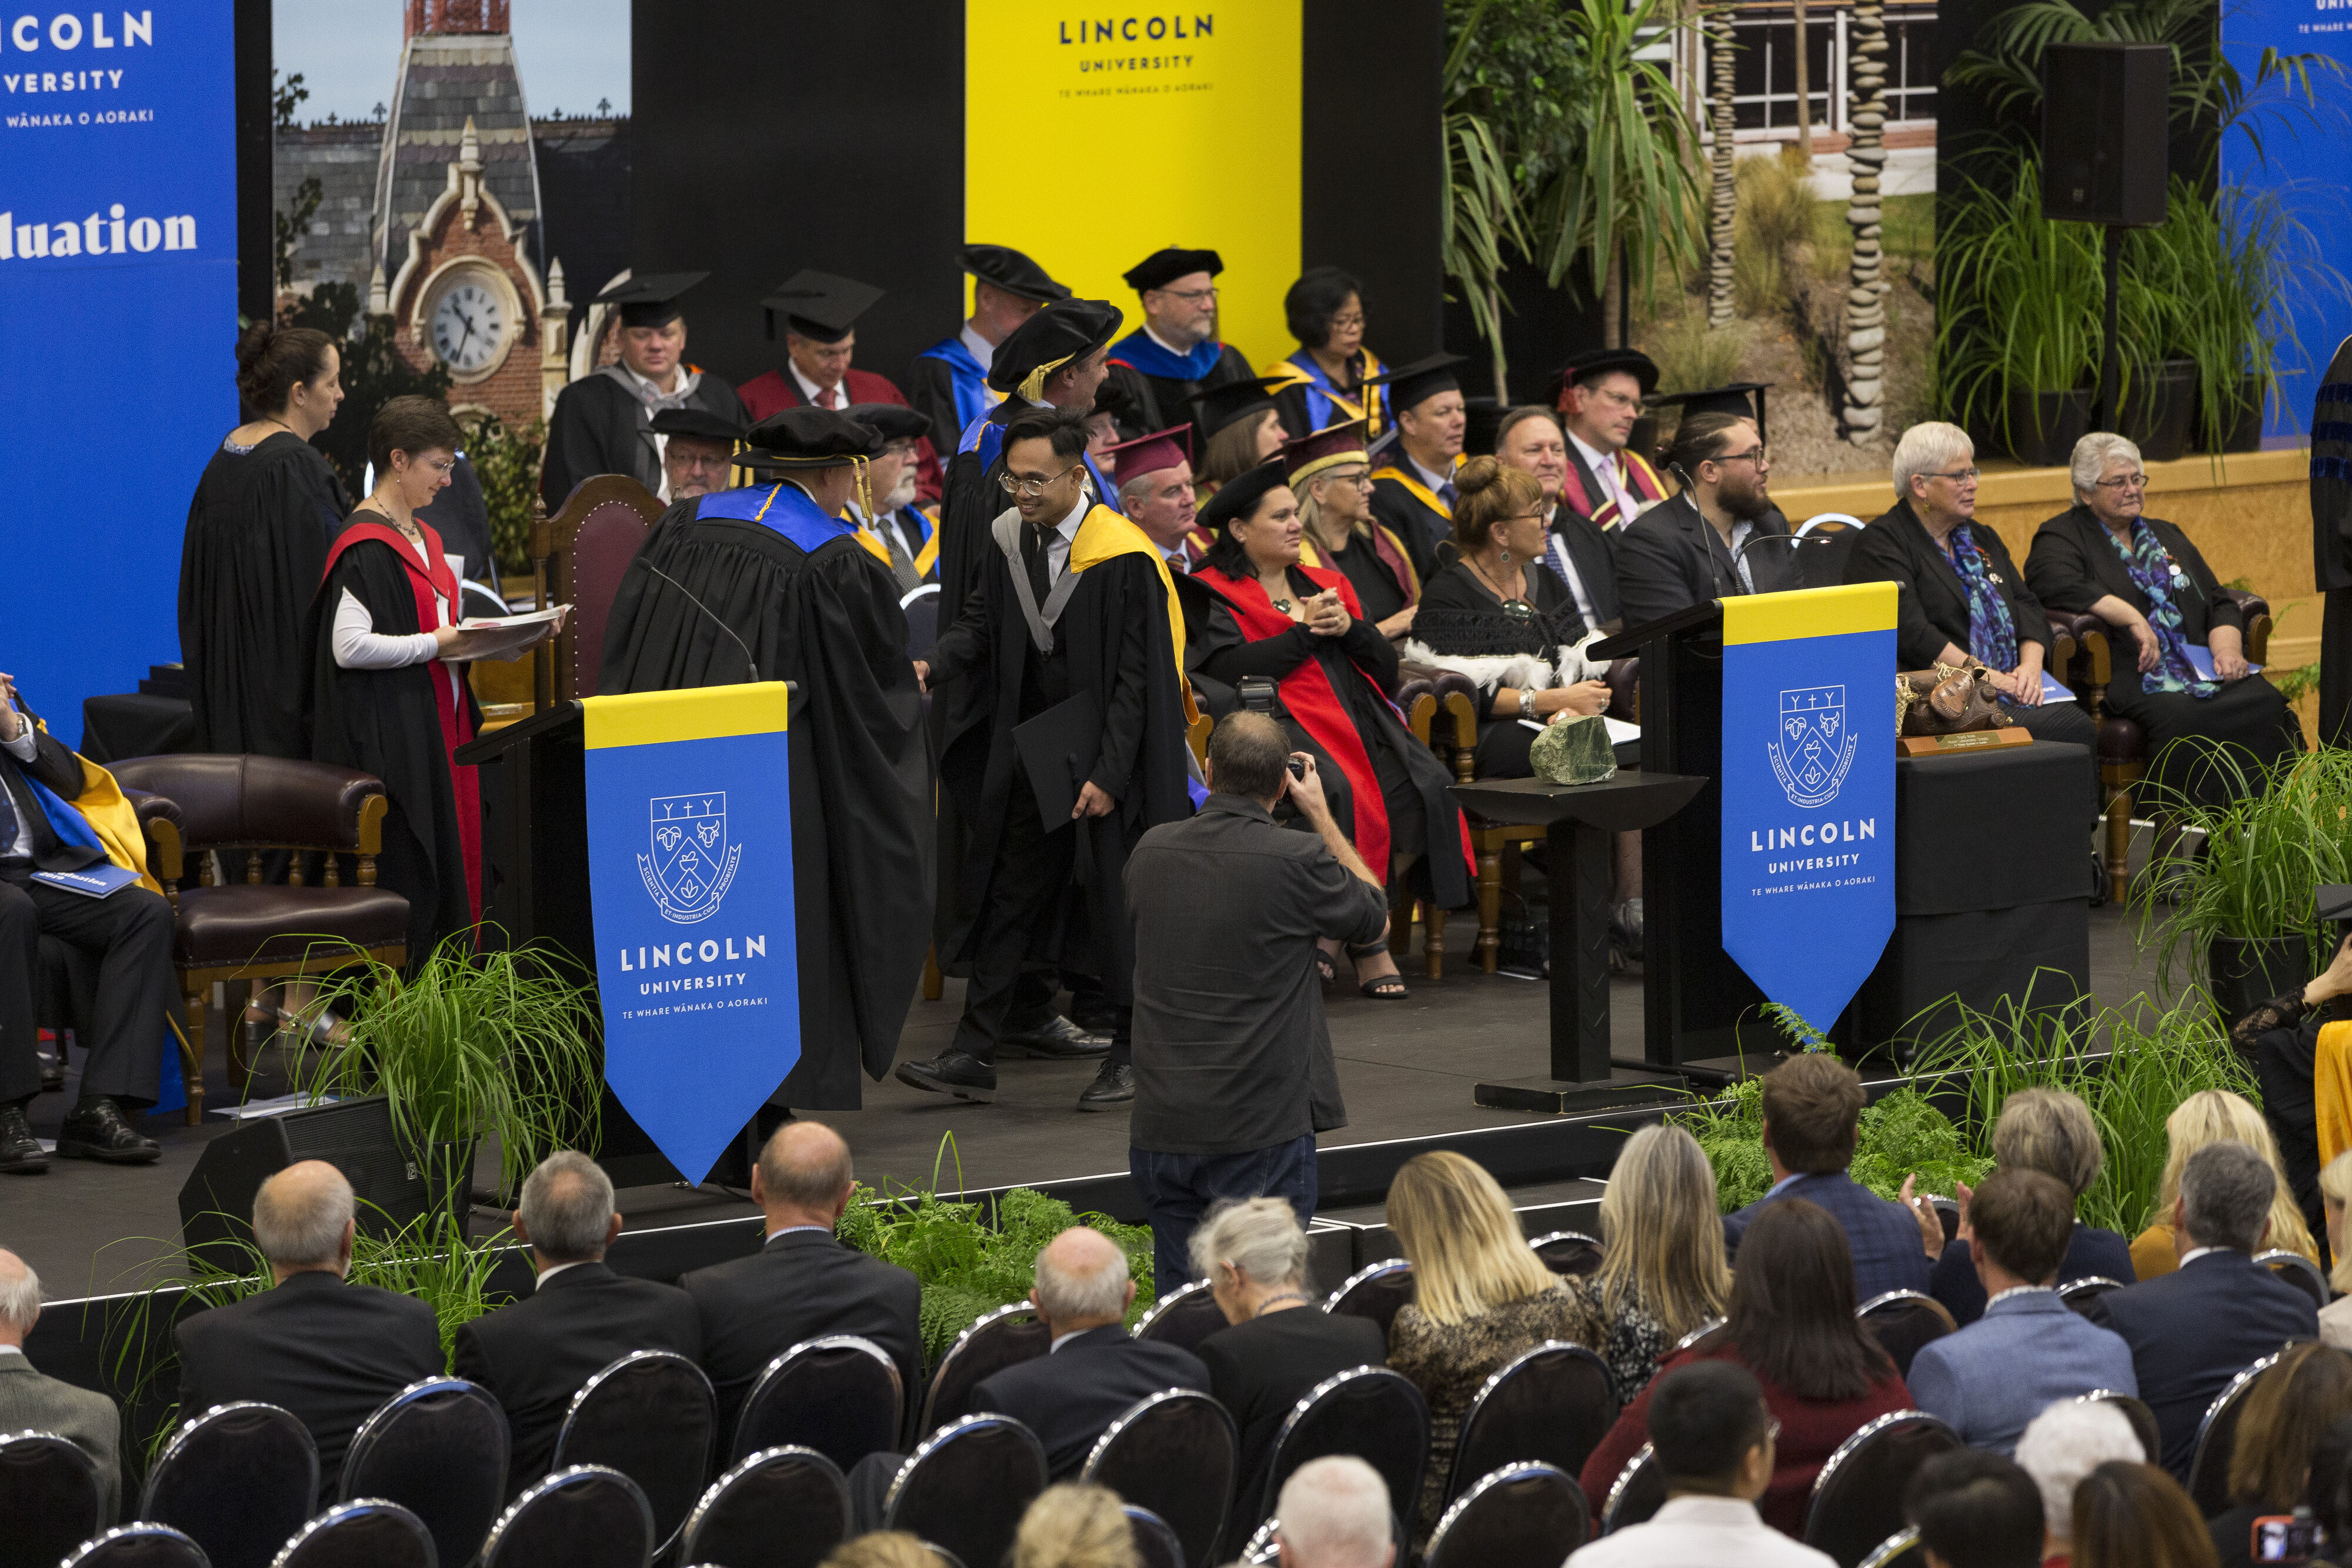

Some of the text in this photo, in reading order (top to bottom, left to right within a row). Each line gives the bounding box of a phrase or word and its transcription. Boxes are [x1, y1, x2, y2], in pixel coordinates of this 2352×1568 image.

[0, 10, 152, 52] COLN
[1060, 14, 1213, 45] LINCOLN
[1080, 55, 1193, 72] UNIVERSITY
[4, 69, 124, 94] VERSITY
[78, 112, 90, 125] O
[95, 109, 154, 124] AORAKI
[1773, 754, 1788, 783] SCIENTIA
[1838, 744, 1853, 778] PROBITATE
[1752, 818, 1875, 852] LINCOLN
[1769, 853, 1859, 874] UNIVERSITY
[643, 866, 660, 898] SCIENTIA
[718, 855, 737, 891] PROBITATE
[1765, 885, 1794, 895] WHARE
[1797, 881, 1832, 891] WĀNAKA
[1844, 876, 1876, 886] AORAKI
[621, 935, 766, 972] LINCOLN
[640, 973, 746, 995] UNIVERSITY
[622, 997, 768, 1019] TE WHARE WĀNAKA O AORAKI
